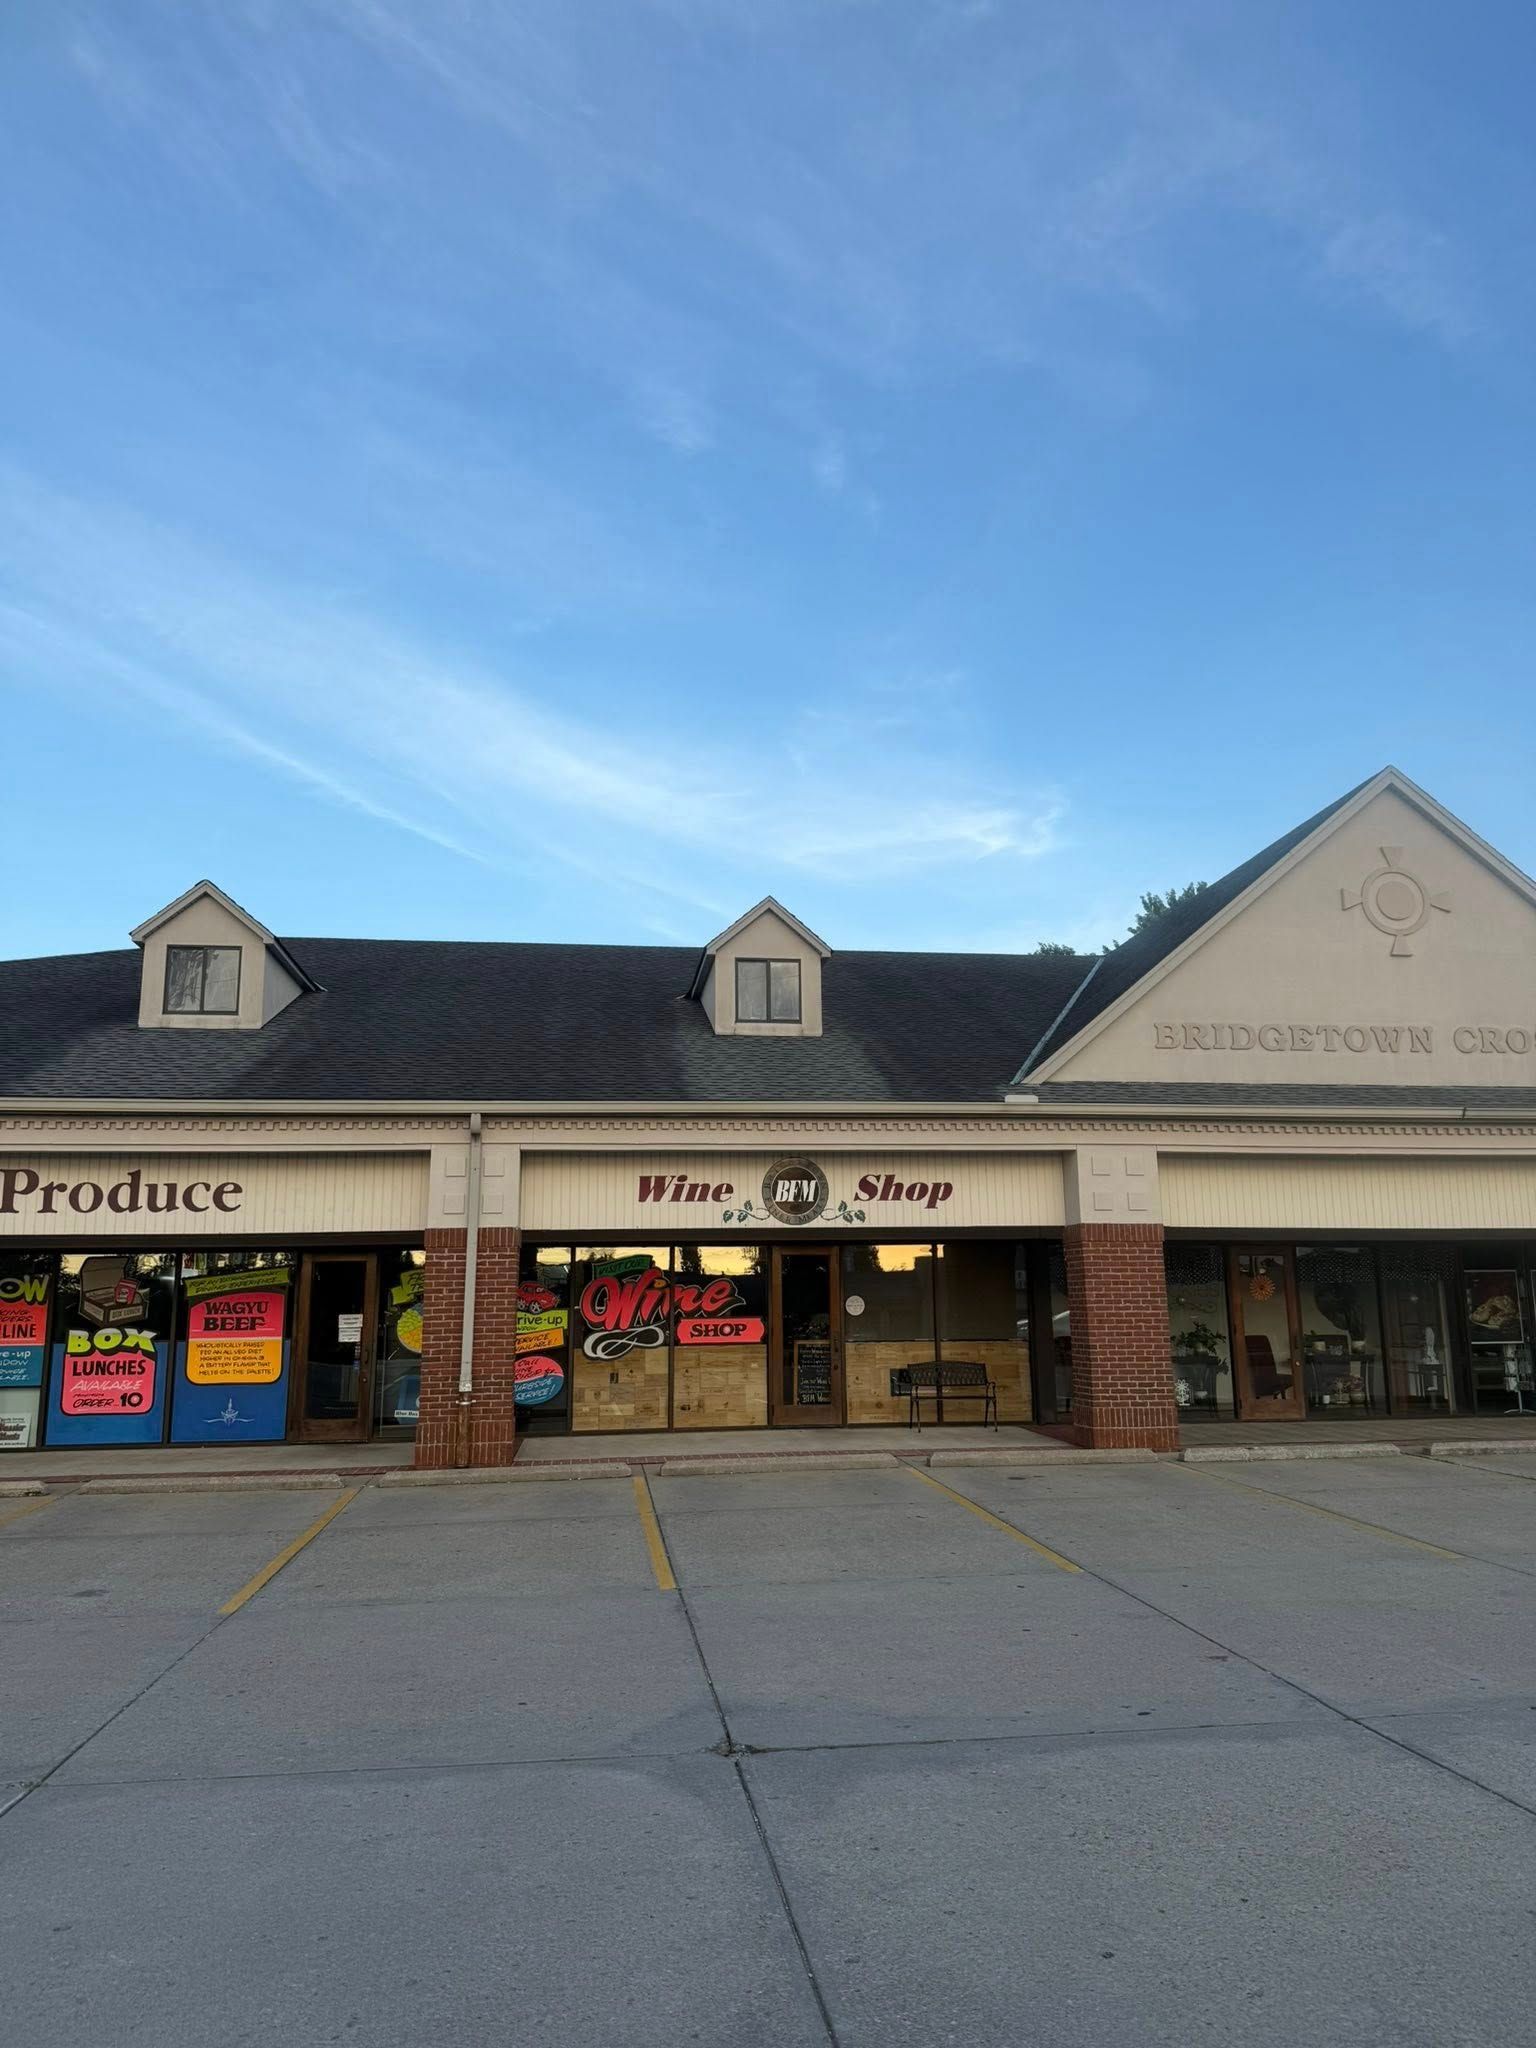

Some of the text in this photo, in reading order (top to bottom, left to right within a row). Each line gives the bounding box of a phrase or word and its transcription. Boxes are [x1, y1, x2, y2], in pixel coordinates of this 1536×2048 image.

[1153, 1022, 1536, 1055] BRIDGETOWN CRO
[0, 1168, 243, 1214] Produce
[637, 1174, 735, 1203] Wine
[853, 1173, 954, 1209] Shop
[775, 1179, 816, 1203] BFM
[205, 1301, 271, 1315] WAGYU
[579, 1267, 746, 1332] Wine
[0, 1323, 37, 1339] LINE
[203, 1316, 266, 1331] BEEF
[689, 1322, 748, 1340] SHOP
[67, 1327, 158, 1354] BOX
[72, 1359, 147, 1377] LUNCHES
[70, 1379, 144, 1392] AVAILABLE
[72, 1392, 144, 1409] ORDER 10
